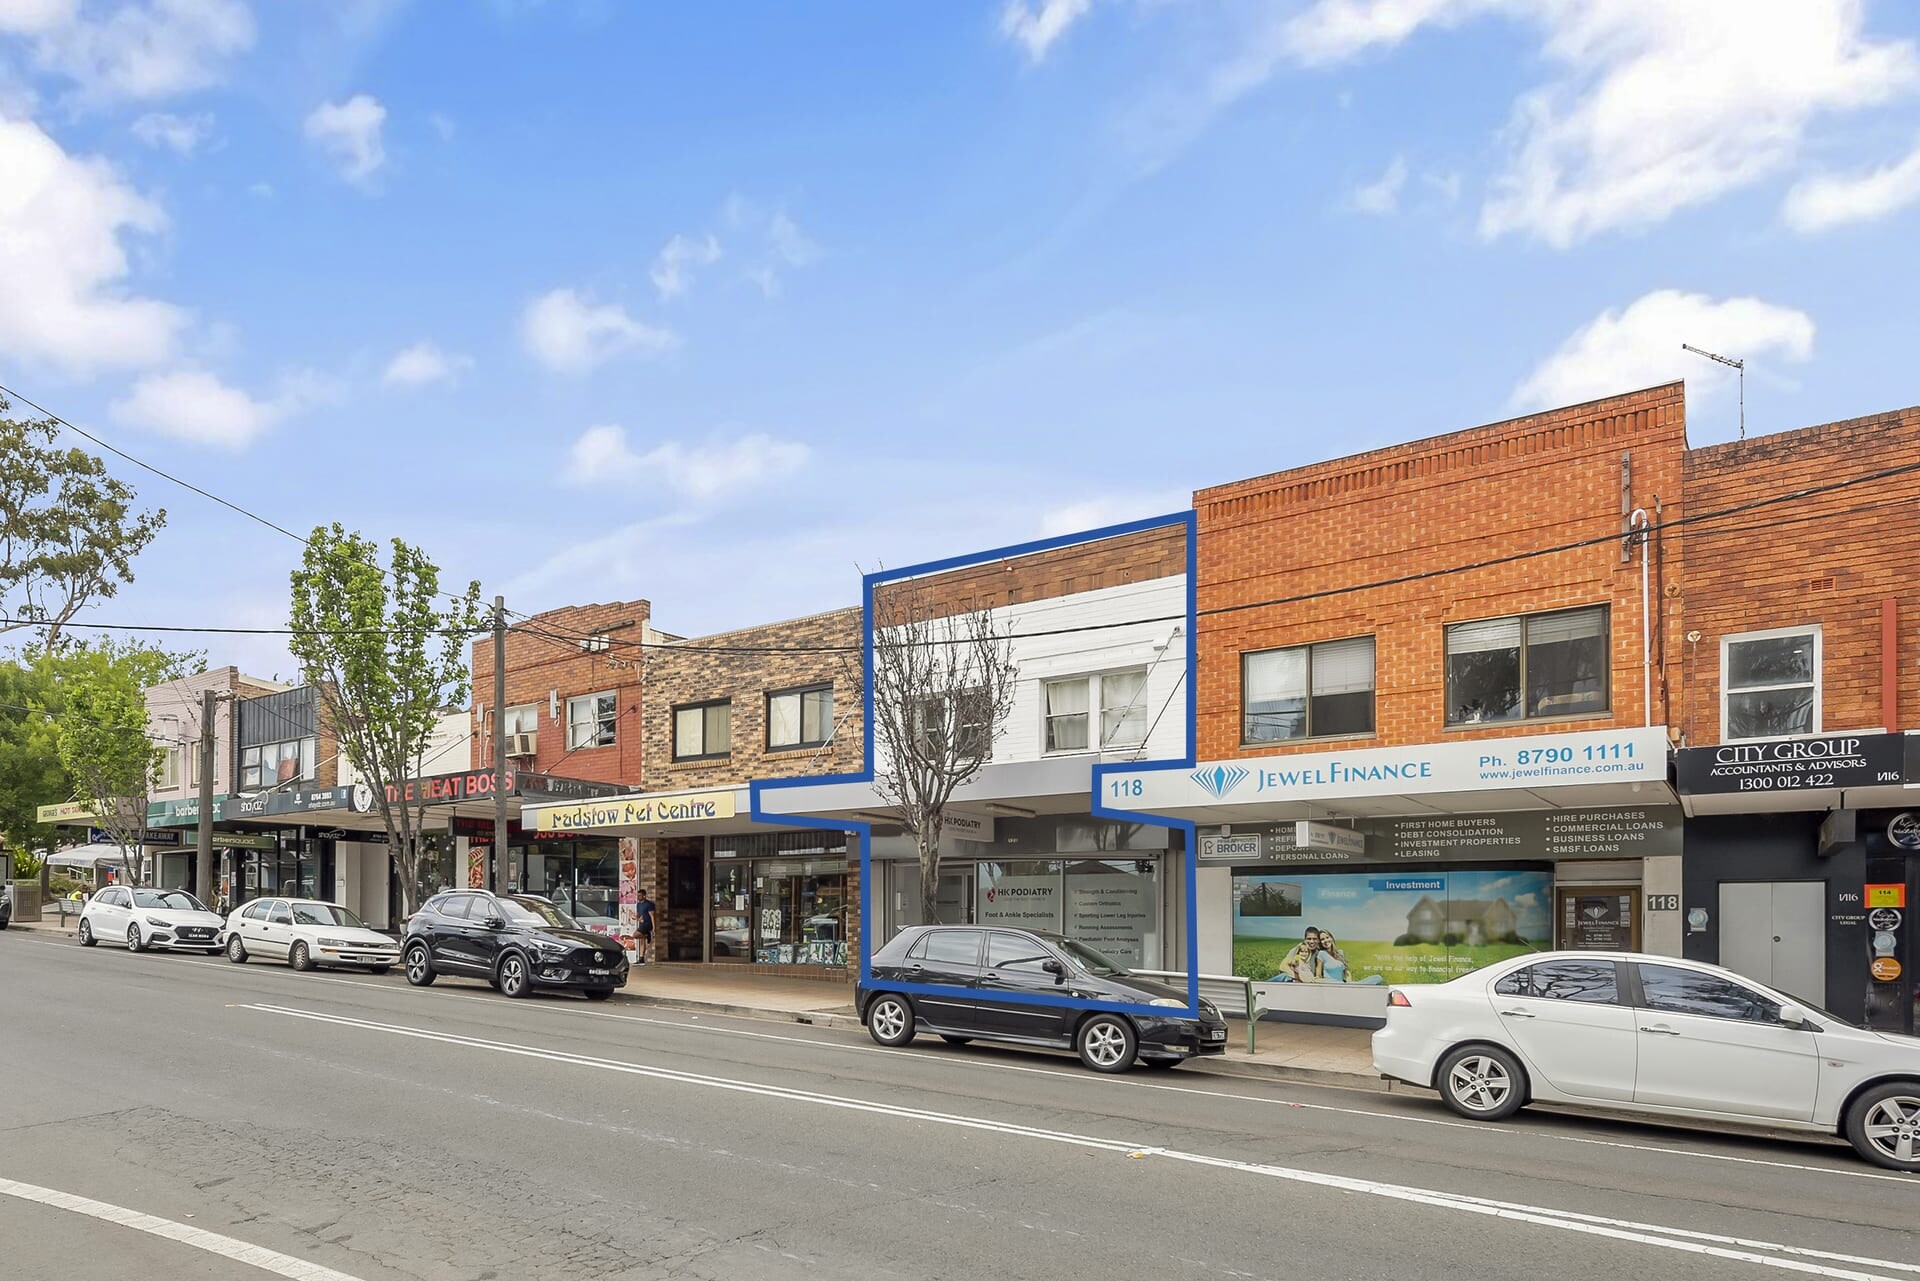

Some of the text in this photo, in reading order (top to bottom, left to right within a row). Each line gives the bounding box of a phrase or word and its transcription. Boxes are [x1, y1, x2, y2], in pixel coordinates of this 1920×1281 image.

[1479, 742, 1633, 767] Ph. 8790 1111
[1716, 739, 1860, 763] CITY GROUP
[1480, 761, 1644, 779] www.jewelfinance.com.au
[1710, 759, 1867, 776] ACCOUNTANTS & ADVISORS
[466, 770, 513, 795] BOSS
[1740, 774, 1834, 790] 1300 012 422
[1111, 779, 1143, 798] 118
[625, 803, 652, 823] Pet
[658, 799, 715, 820] Centre
[1580, 812, 1645, 821] PURCHASES
[1428, 820, 1455, 828] HOME
[1457, 819, 1496, 827] BUYERS
[1553, 821, 1664, 832] COMMERCIAL LOANS
[145, 833, 174, 841] AKEAWAY
[1400, 828, 1504, 839] DEBT CONSOLIDATION
[1553, 832, 1645, 843] BUSINESS LOANS
[1216, 842, 1256, 853] BROKER
[1400, 837, 1521, 848] INVESTMENT PROPERTIES
[1400, 849, 1440, 858] LEASING
[1553, 844, 1620, 853] SMSF LOANS
[1275, 852, 1349, 861] PERSONAL LOANS
[1386, 881, 1441, 890] Investment
[1011, 888, 1053, 896] PODIATRY
[1649, 896, 1678, 909] 118
